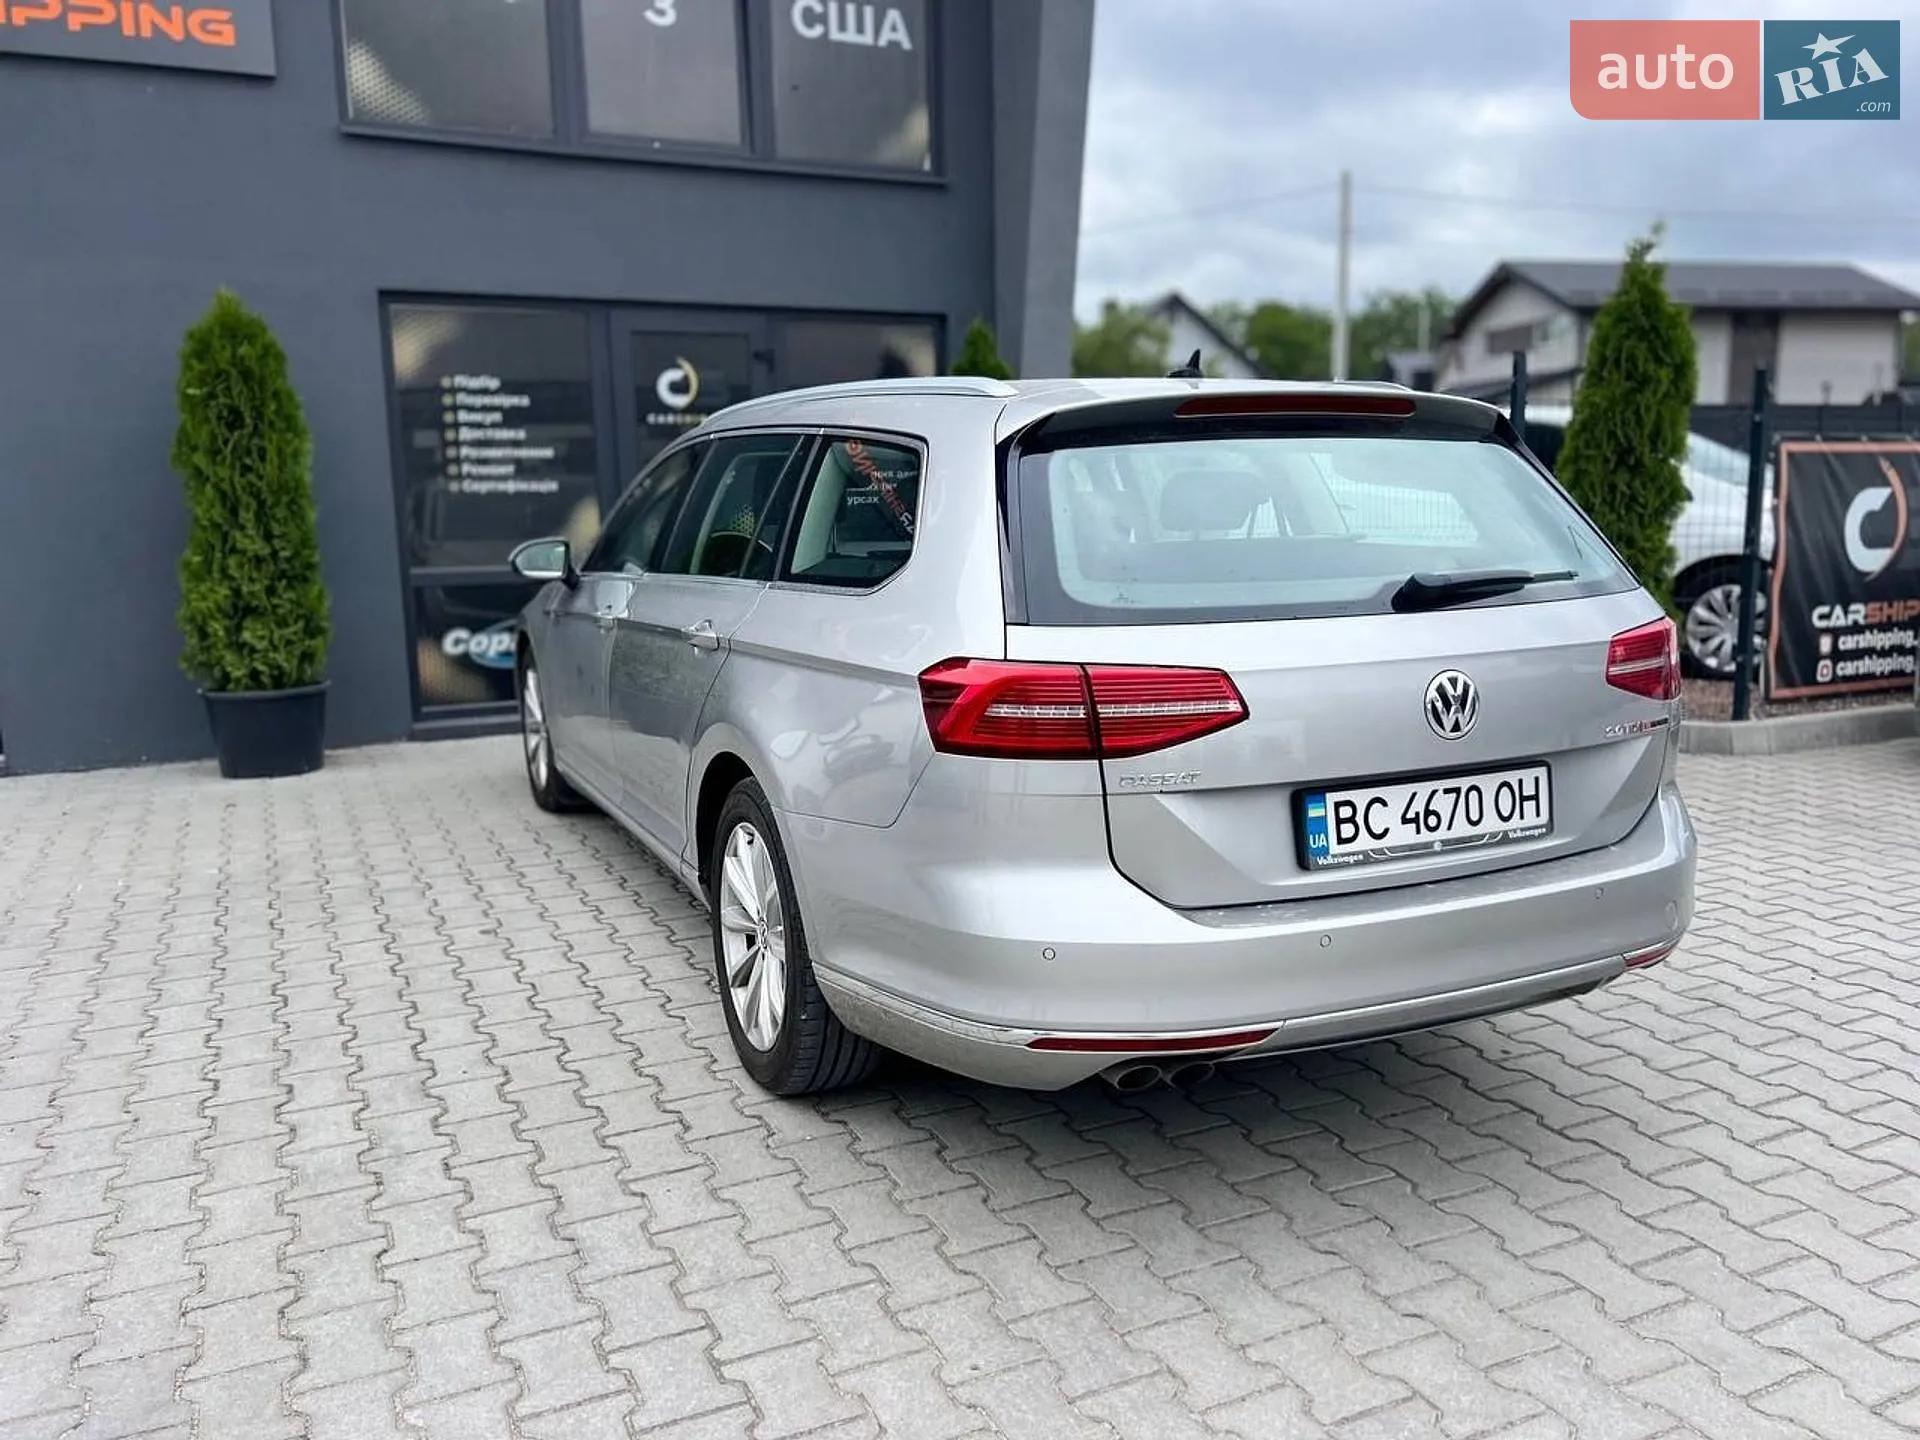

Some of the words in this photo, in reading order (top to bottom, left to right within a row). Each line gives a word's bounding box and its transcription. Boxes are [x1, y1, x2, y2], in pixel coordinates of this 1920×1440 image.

[791, 0, 913, 50] США
[1119, 769, 1202, 787] PASSAT
[1333, 796, 1390, 846] BC
[1401, 784, 1484, 835] 4670
[1495, 776, 1541, 823] OH
[1310, 834, 1328, 849] UA
[1316, 853, 1364, 866] Volkswagen
